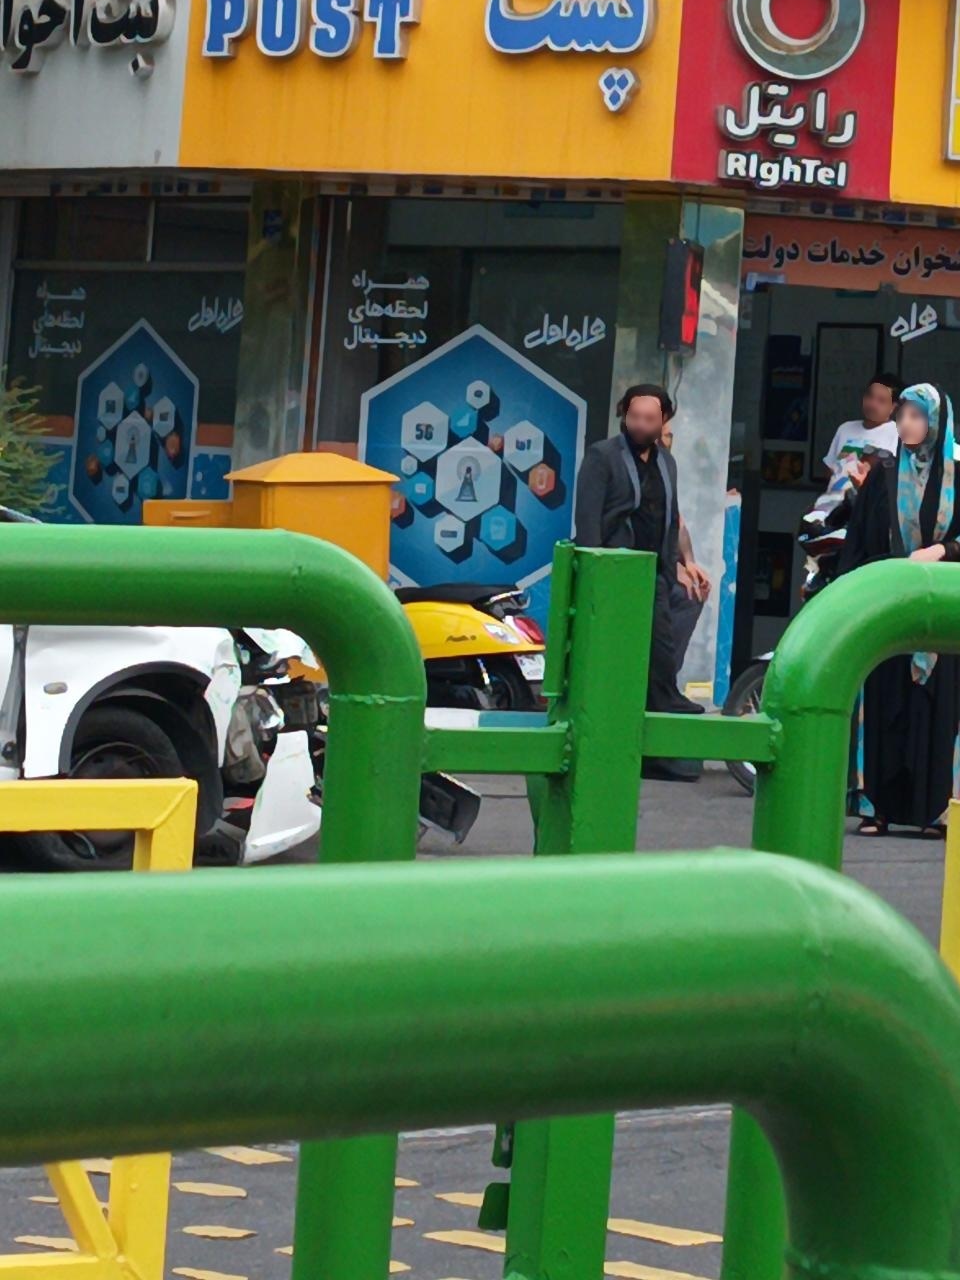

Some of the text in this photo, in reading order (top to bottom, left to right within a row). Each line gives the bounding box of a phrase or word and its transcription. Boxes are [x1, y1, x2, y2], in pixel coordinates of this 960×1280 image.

[722, 82, 857, 146] رایتل
[743, 234, 800, 268] دولت
[807, 239, 885, 266] خدمات
[352, 269, 430, 295] همراه
[344, 325, 427, 352] دیجیتال
